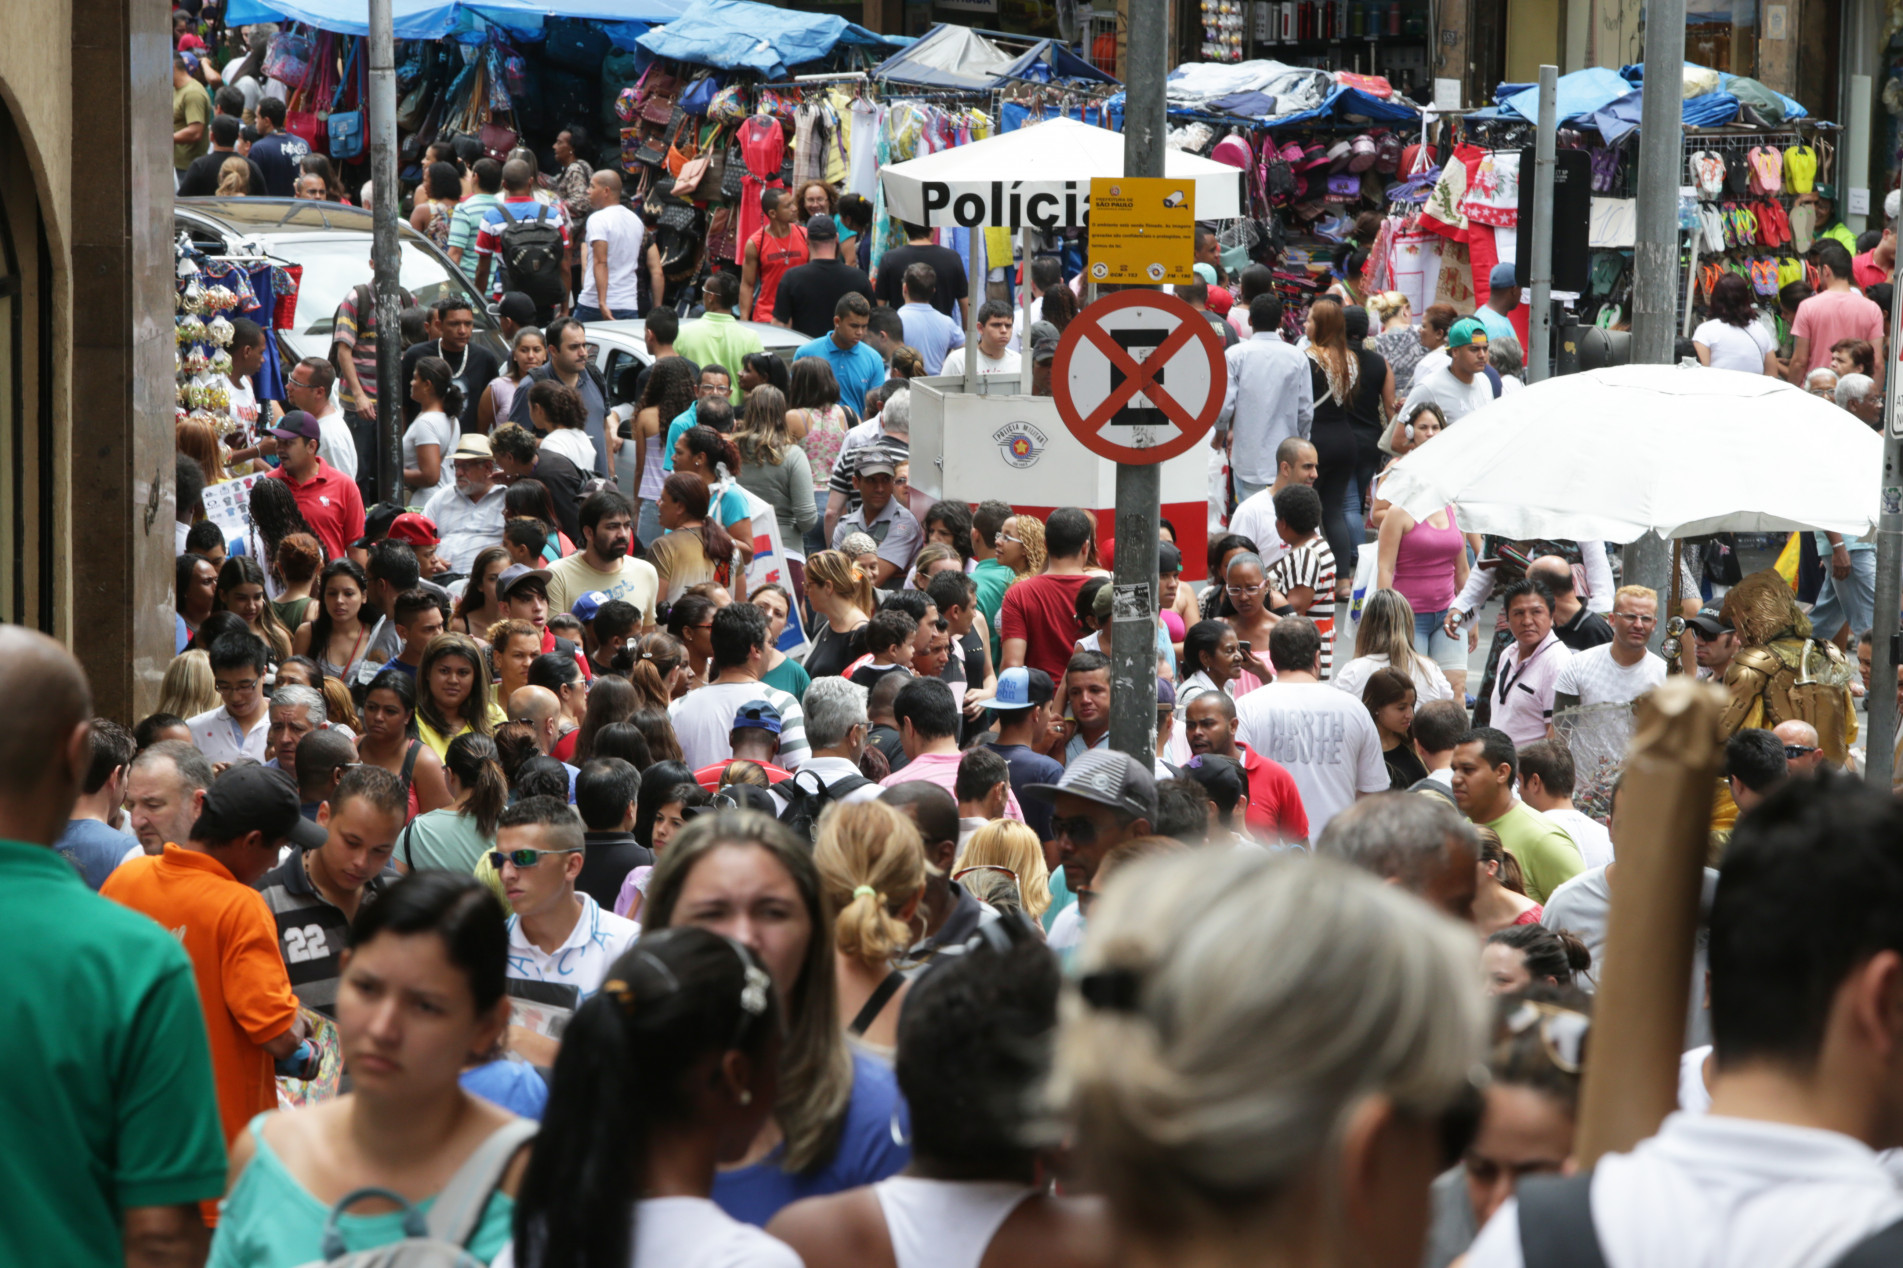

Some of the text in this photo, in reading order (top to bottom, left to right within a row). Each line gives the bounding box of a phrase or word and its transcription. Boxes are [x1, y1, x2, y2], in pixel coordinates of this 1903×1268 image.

[922, 181, 1090, 228] Políci
[1269, 709, 1345, 738] NORTH
[1268, 735, 1342, 765] ROUTE
[284, 923, 330, 963] 22
